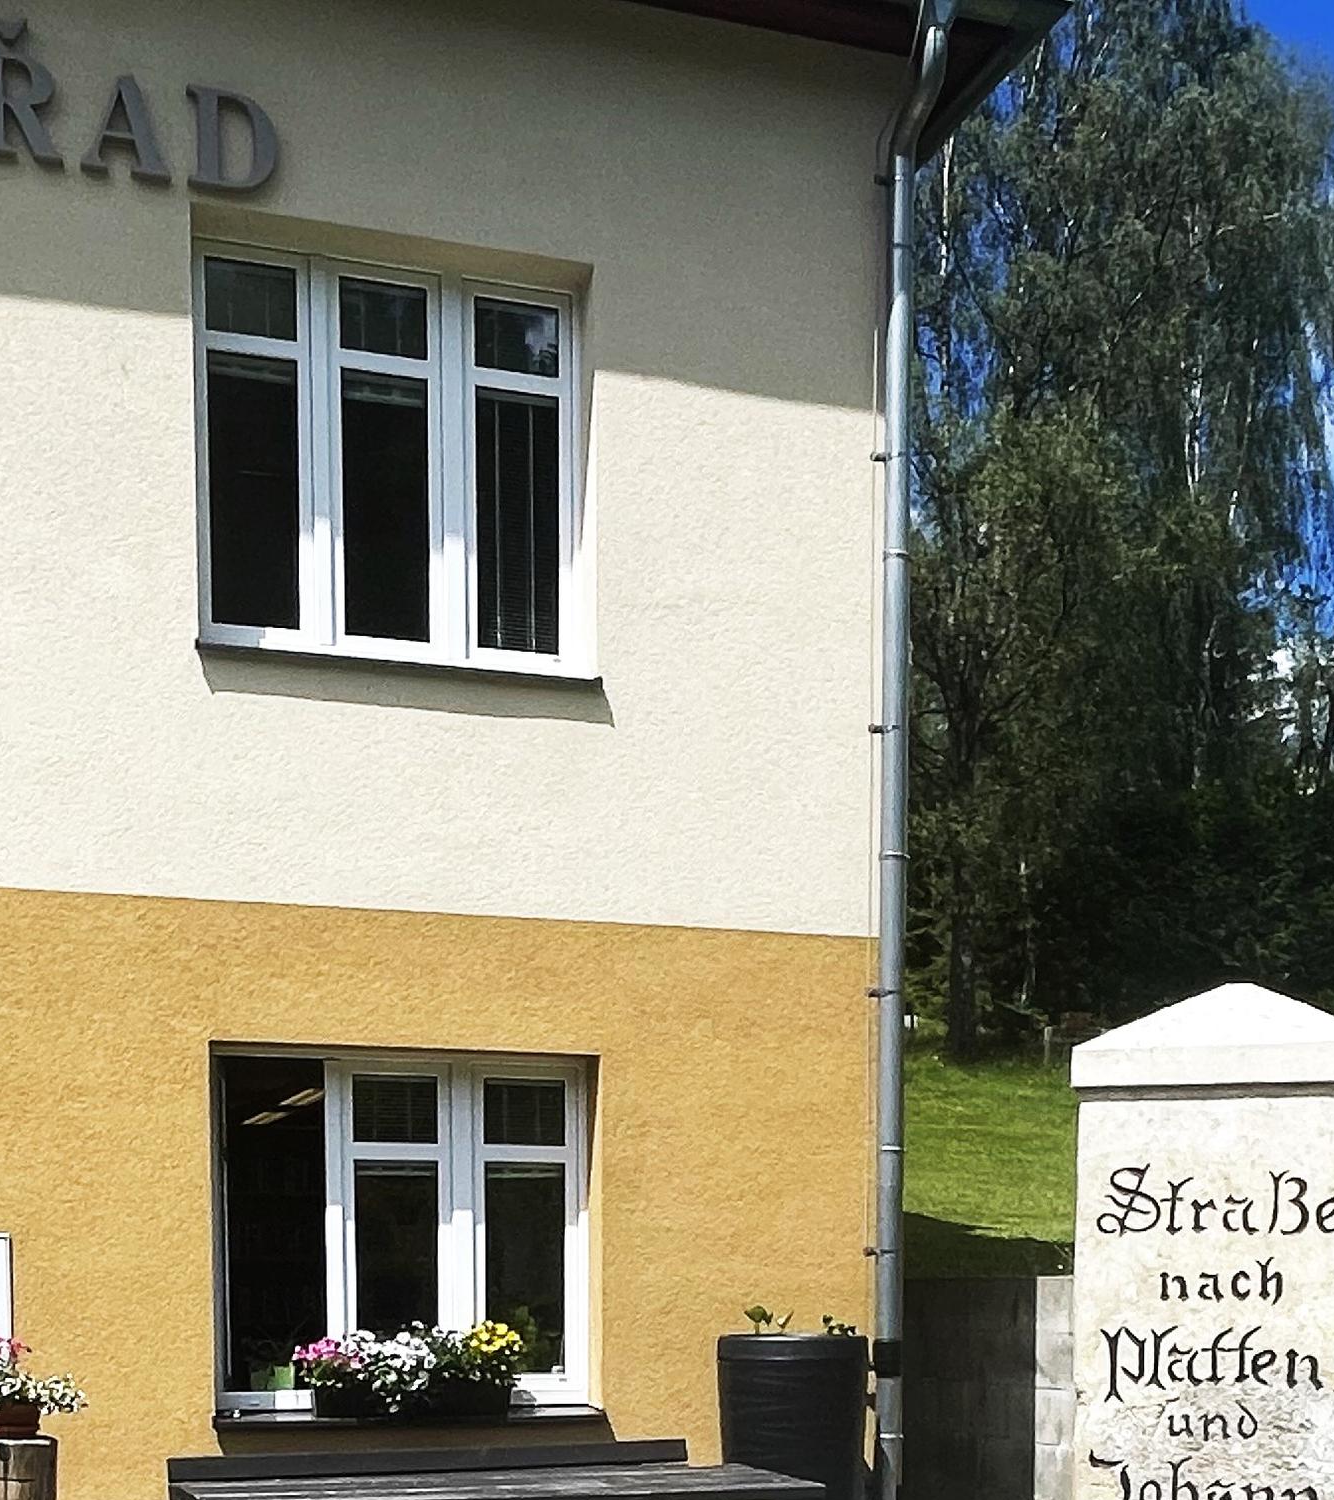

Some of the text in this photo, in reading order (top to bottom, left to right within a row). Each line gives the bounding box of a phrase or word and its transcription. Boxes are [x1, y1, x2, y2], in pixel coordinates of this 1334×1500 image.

[1159, 1257, 1283, 1305] nach
[1099, 1325, 1323, 1402] Platten
[1167, 1399, 1258, 1441] und
